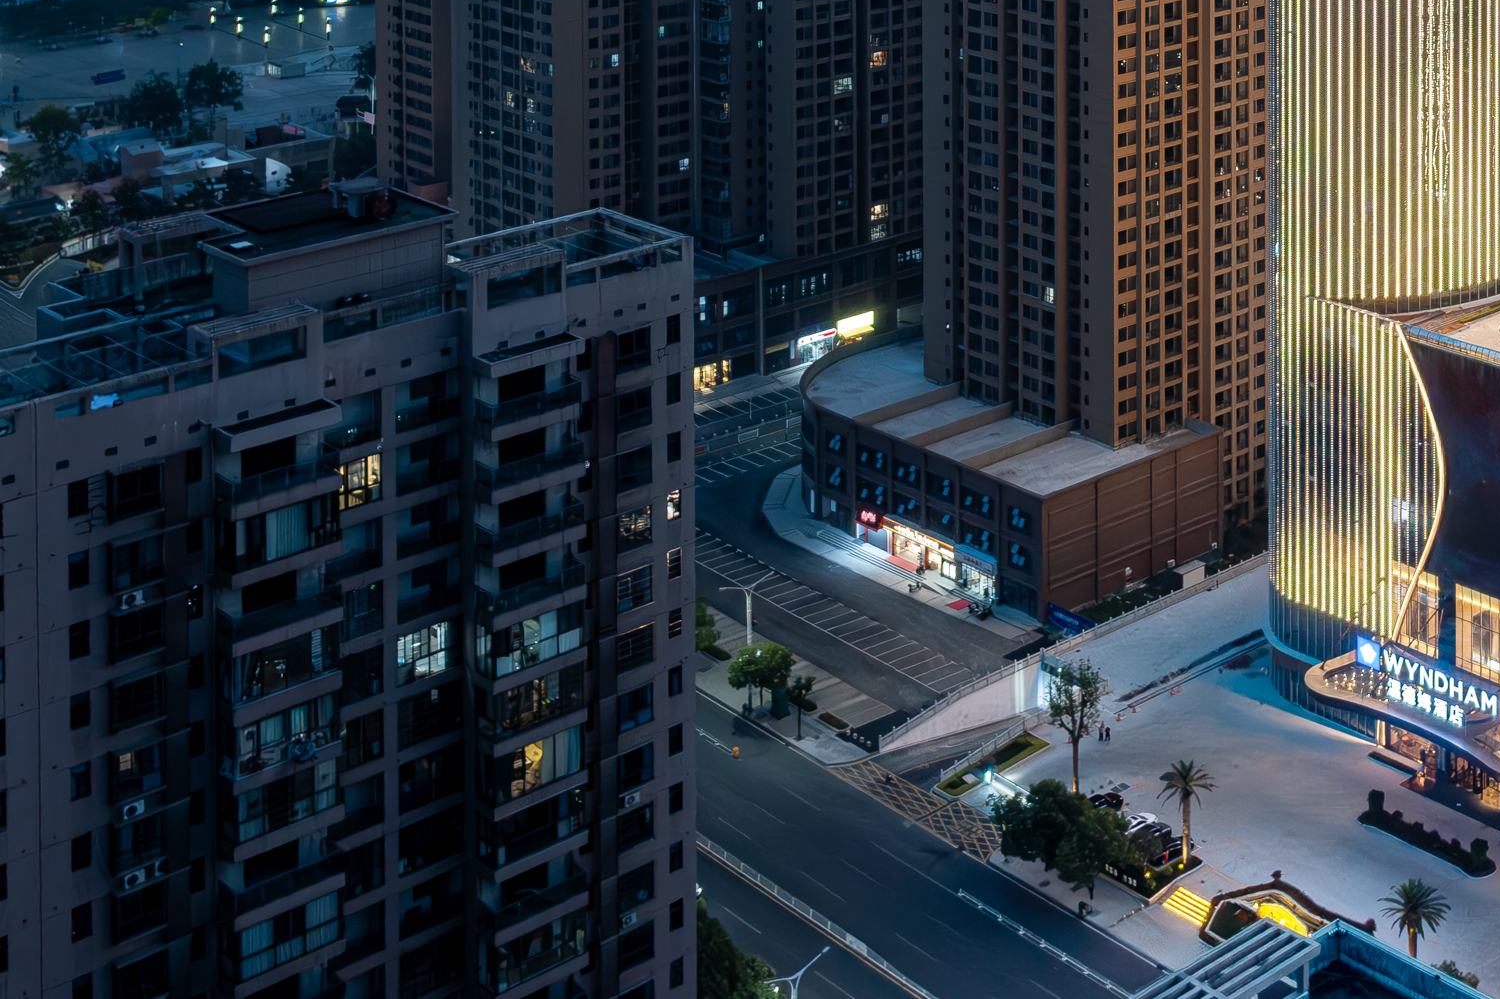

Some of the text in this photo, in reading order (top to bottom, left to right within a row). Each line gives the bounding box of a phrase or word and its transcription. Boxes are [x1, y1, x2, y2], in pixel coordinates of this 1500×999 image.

[1382, 649, 1498, 716] WYNDHAM
[1387, 677, 1465, 727] 温德姆酒店
